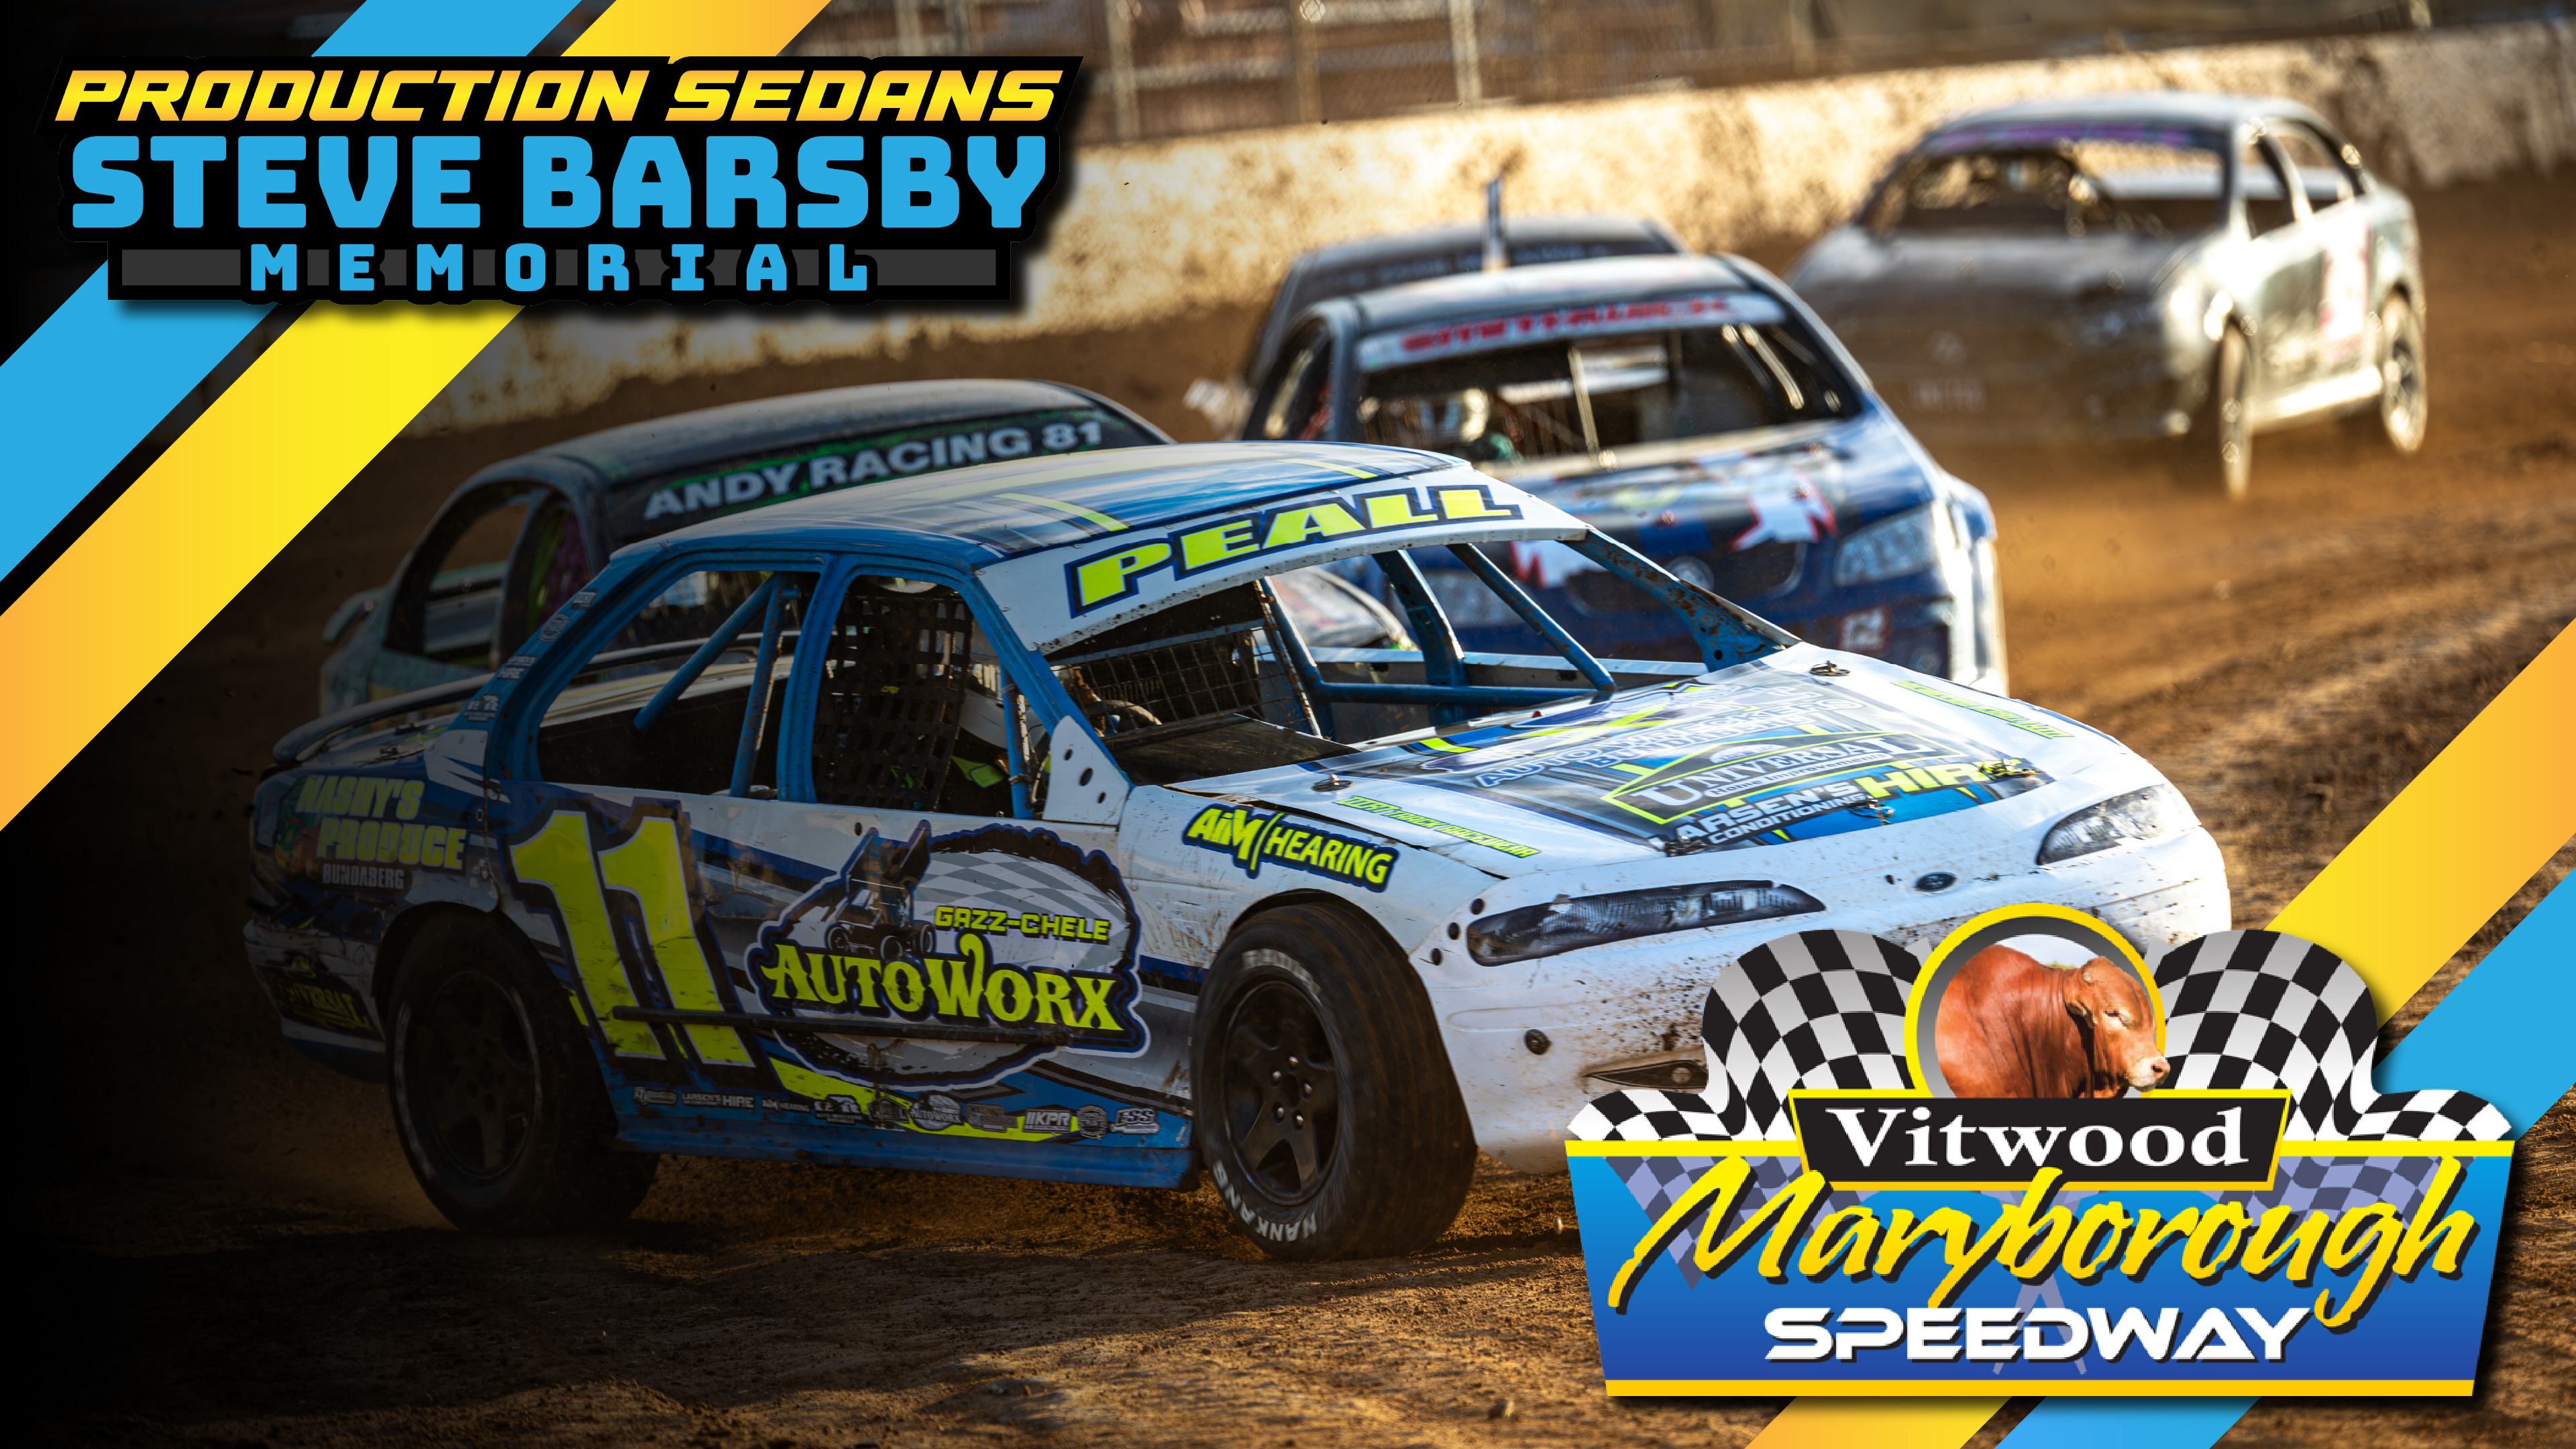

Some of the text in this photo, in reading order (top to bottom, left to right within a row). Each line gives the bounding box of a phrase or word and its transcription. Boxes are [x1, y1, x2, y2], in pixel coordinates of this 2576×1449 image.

[643, 421, 1103, 520] ANDY RACING 81
[1076, 488, 1513, 608] PEALL
[1478, 747, 1599, 787] AUTO
[1599, 699, 1860, 750] WRECKERS
[1587, 716, 1815, 767] BUNDABERG
[295, 774, 425, 820] NASHY'S
[1630, 737, 1937, 806] UNIVERSAL
[1710, 780, 1762, 796] Home
[1764, 752, 1888, 782] Improvements
[317, 817, 468, 870] PRODUCE
[1707, 793, 1867, 844] CONDITIONING
[322, 863, 404, 889] BUNDABERG
[1264, 826, 1394, 884] HEARING
[510, 810, 757, 1068] 11
[934, 905, 1110, 941] GAZZ-CHELE
[759, 933, 1126, 1030] AUTOWORX
[722, 1095, 755, 1108] HIRE
